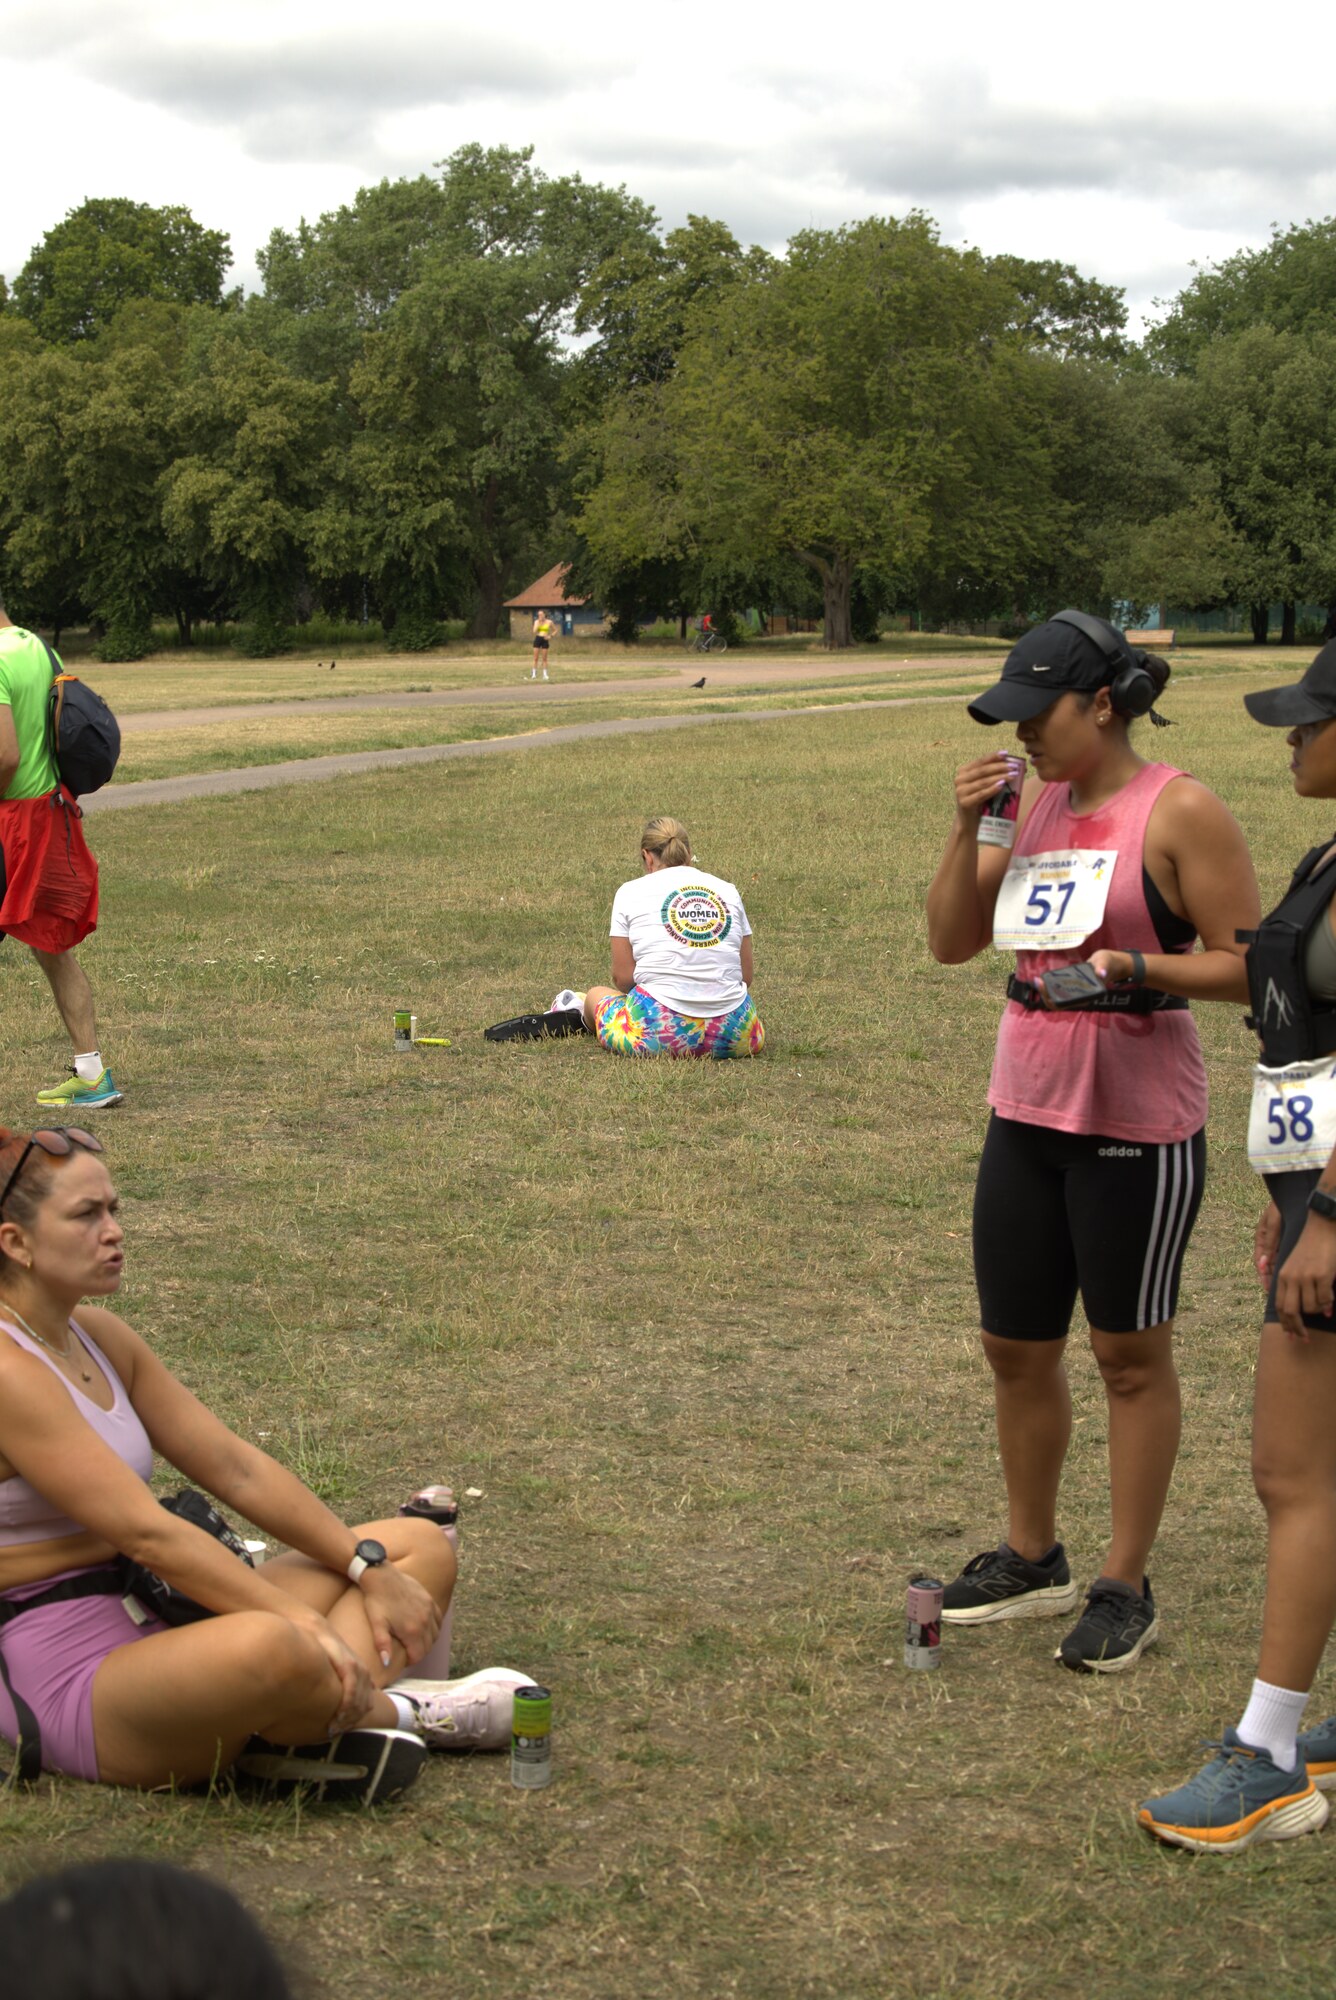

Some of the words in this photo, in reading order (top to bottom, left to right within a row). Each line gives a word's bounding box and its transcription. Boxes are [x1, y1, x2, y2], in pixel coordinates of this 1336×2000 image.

[680, 885, 715, 896] INCLUSION
[661, 890, 679, 923] TRIATHLON
[672, 896, 683, 908] BIKE
[680, 898, 715, 909] COMMUNITY
[1025, 881, 1076, 926] 57
[710, 896, 725, 922] SUPPORT
[670, 910, 683, 932] INSPIRE
[685, 922, 714, 932] TOGETHER
[718, 915, 732, 940] STRONG
[665, 923, 687, 944] CHANGE
[685, 931, 711, 939] ACHIEVE
[712, 922, 723, 935] RUN
[691, 939, 719, 947] DIVERSE
[1268, 1095, 1314, 1145] 58
[1098, 1146, 1142, 1157] adidas
